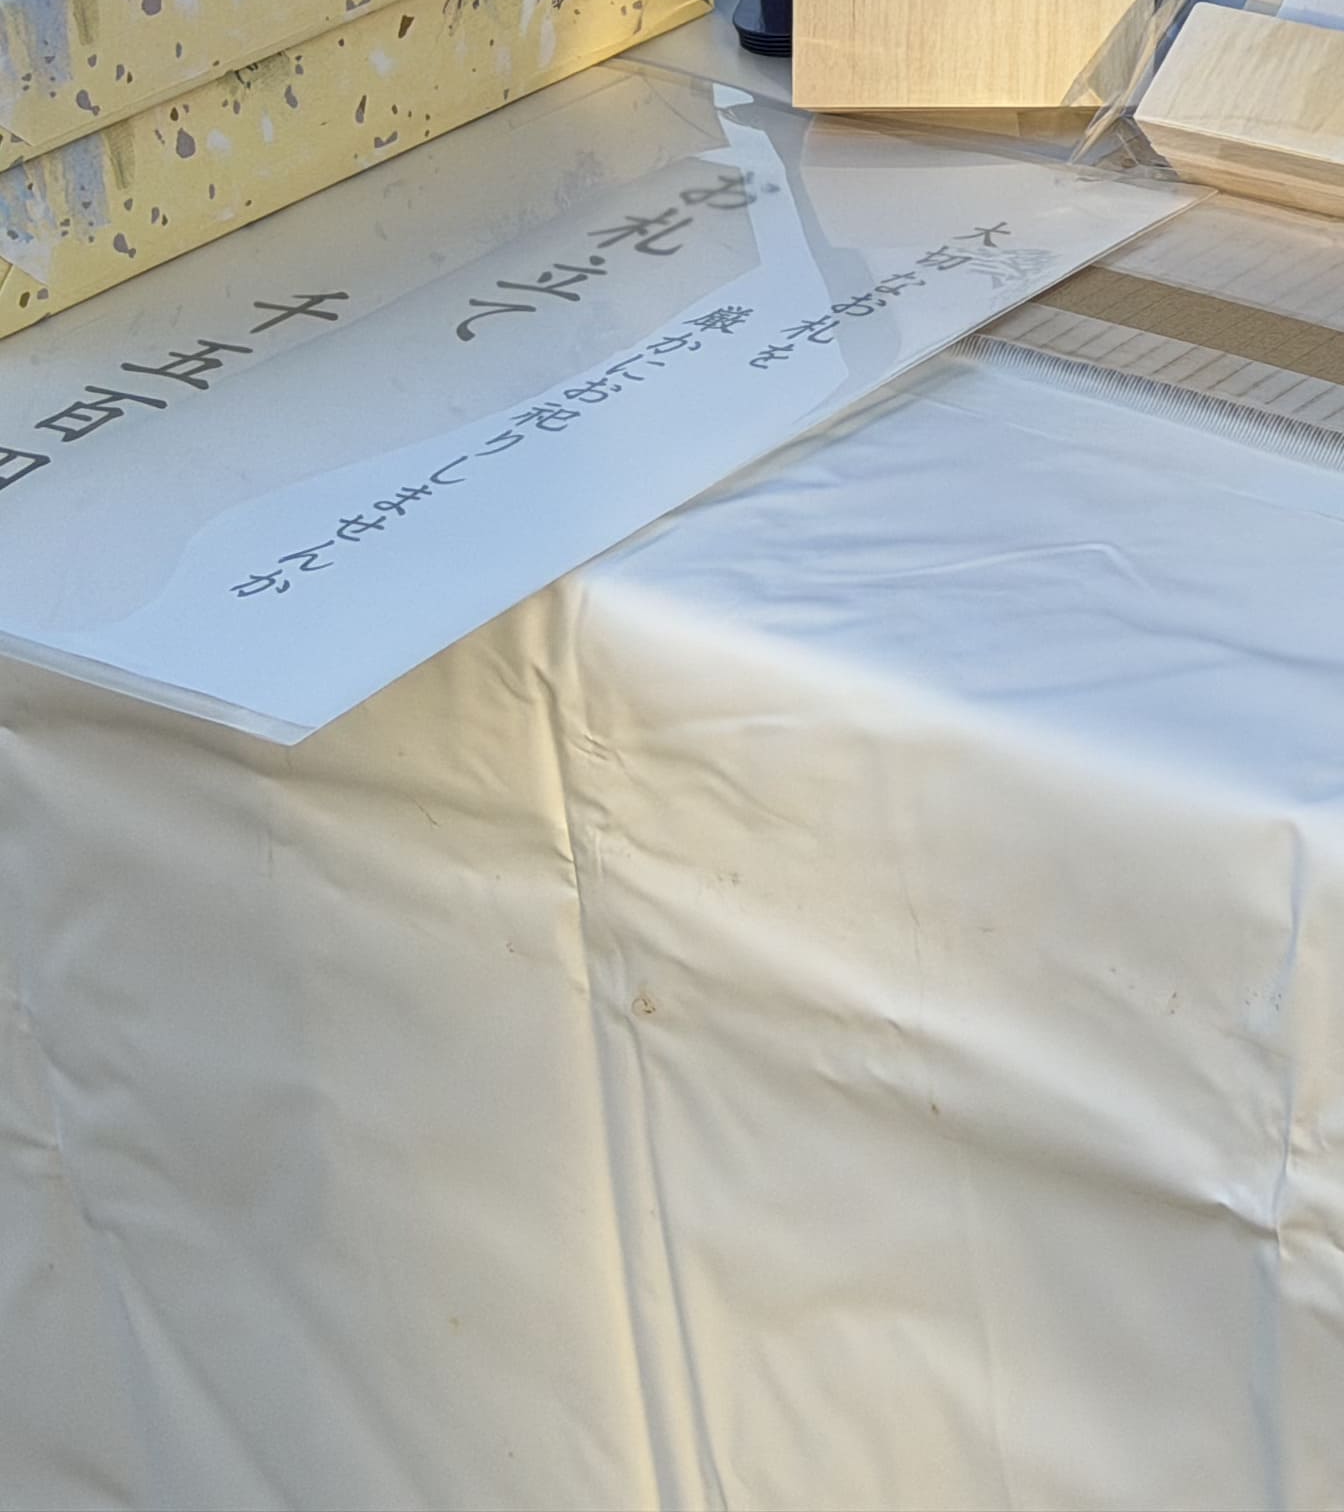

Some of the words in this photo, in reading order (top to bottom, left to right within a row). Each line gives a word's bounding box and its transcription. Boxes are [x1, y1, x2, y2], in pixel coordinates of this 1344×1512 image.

[456, 170, 780, 343] お札立て
[748, 222, 1012, 369] 大切なお札を
[231, 305, 753, 599] 厳かにお祀りしませんか
